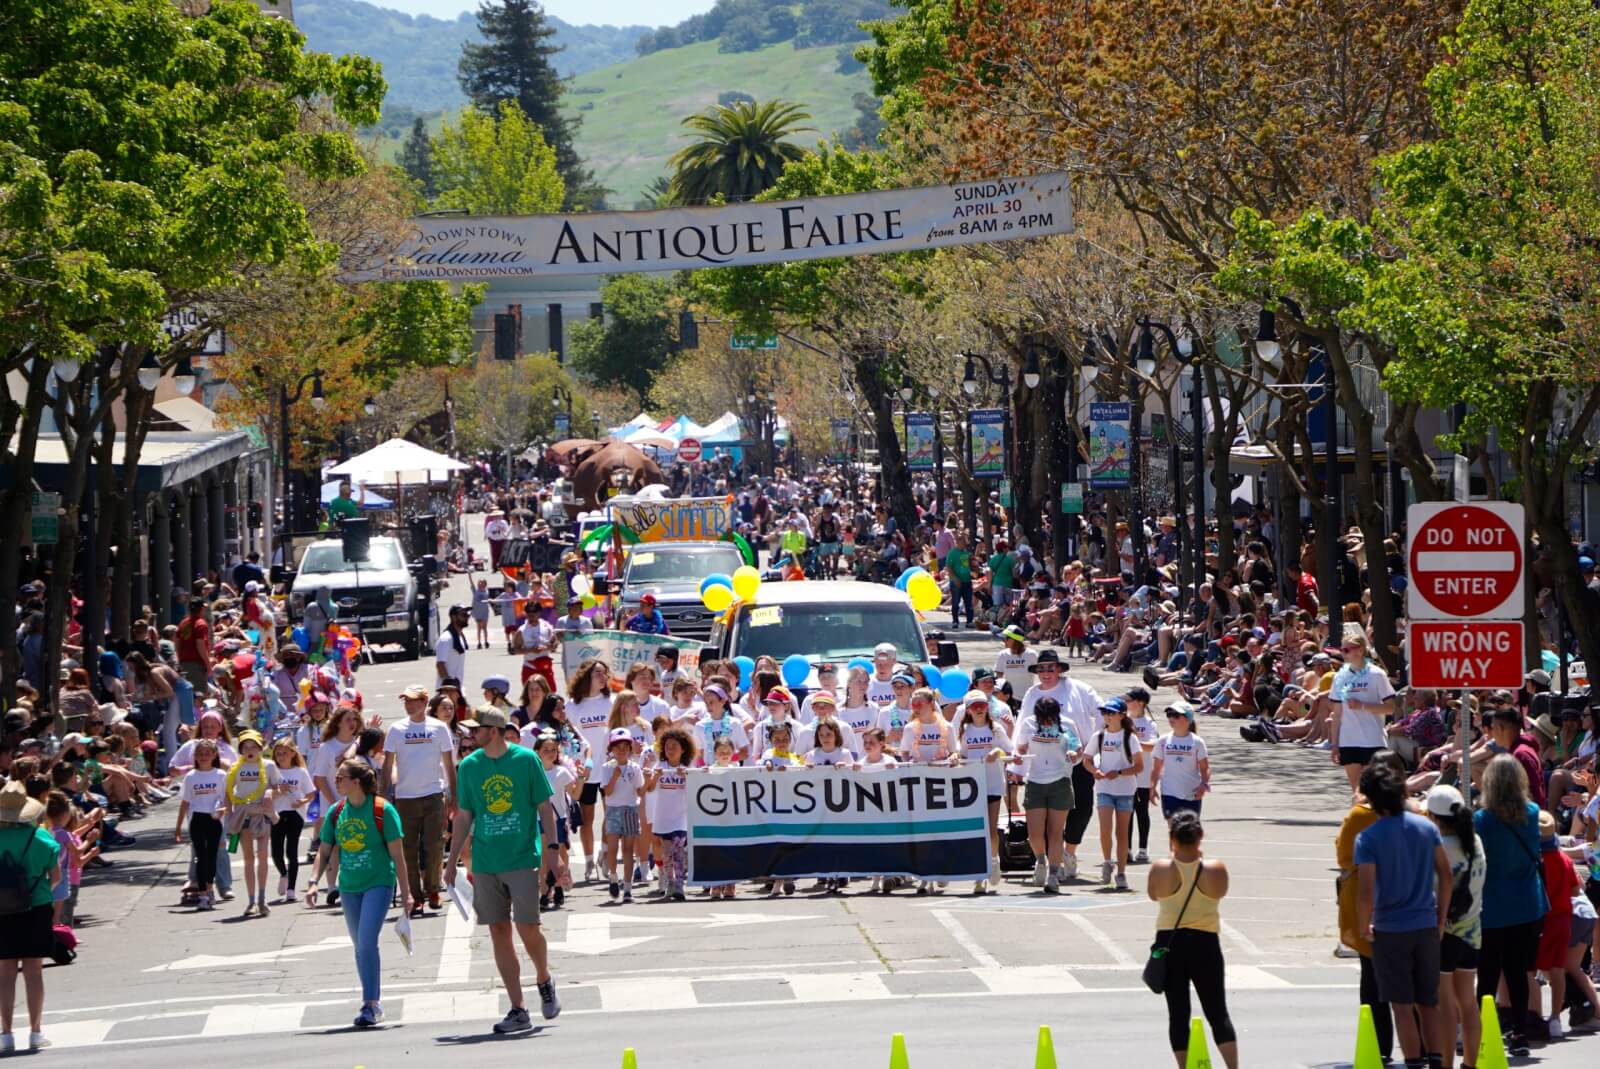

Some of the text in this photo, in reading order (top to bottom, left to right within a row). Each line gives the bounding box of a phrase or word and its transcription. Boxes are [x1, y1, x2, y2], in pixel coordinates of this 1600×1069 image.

[954, 182, 1018, 201] SUNDAY
[953, 199, 1022, 219] APRIL 30
[425, 226, 528, 247] DOWNTOWN
[546, 205, 904, 264] ANTIQUE FAIRE
[927, 213, 1054, 242] from 8AM to 4PM
[1426, 527, 1506, 546] DO NOT
[1433, 577, 1498, 596] ENTER
[1422, 631, 1511, 653] WRONG
[612, 647, 650, 661] GREAT
[1439, 658, 1493, 680] WAY
[580, 715, 607, 724] CAMP
[405, 732, 433, 740] CAMP
[966, 736, 993, 744] CAMP
[1165, 743, 1193, 751] CAMP
[193, 782, 217, 791] CAMP
[659, 777, 686, 785] CAMP
